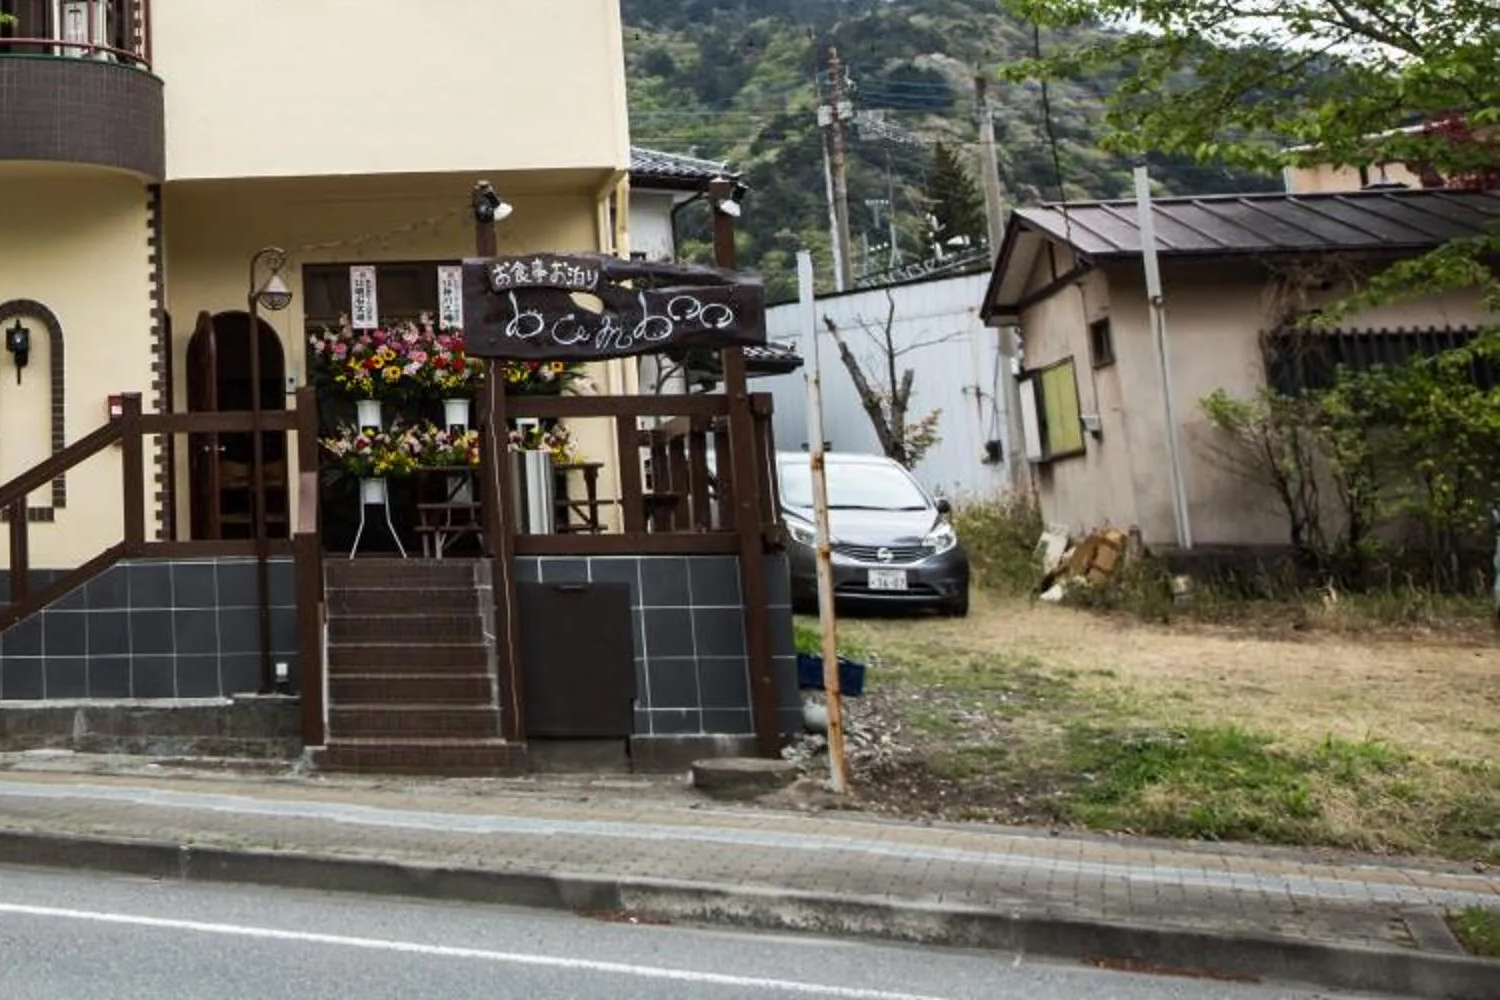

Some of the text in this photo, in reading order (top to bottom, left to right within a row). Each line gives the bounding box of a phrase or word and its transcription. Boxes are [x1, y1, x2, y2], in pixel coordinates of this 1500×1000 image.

[491, 258, 599, 287] お食事お泊り
